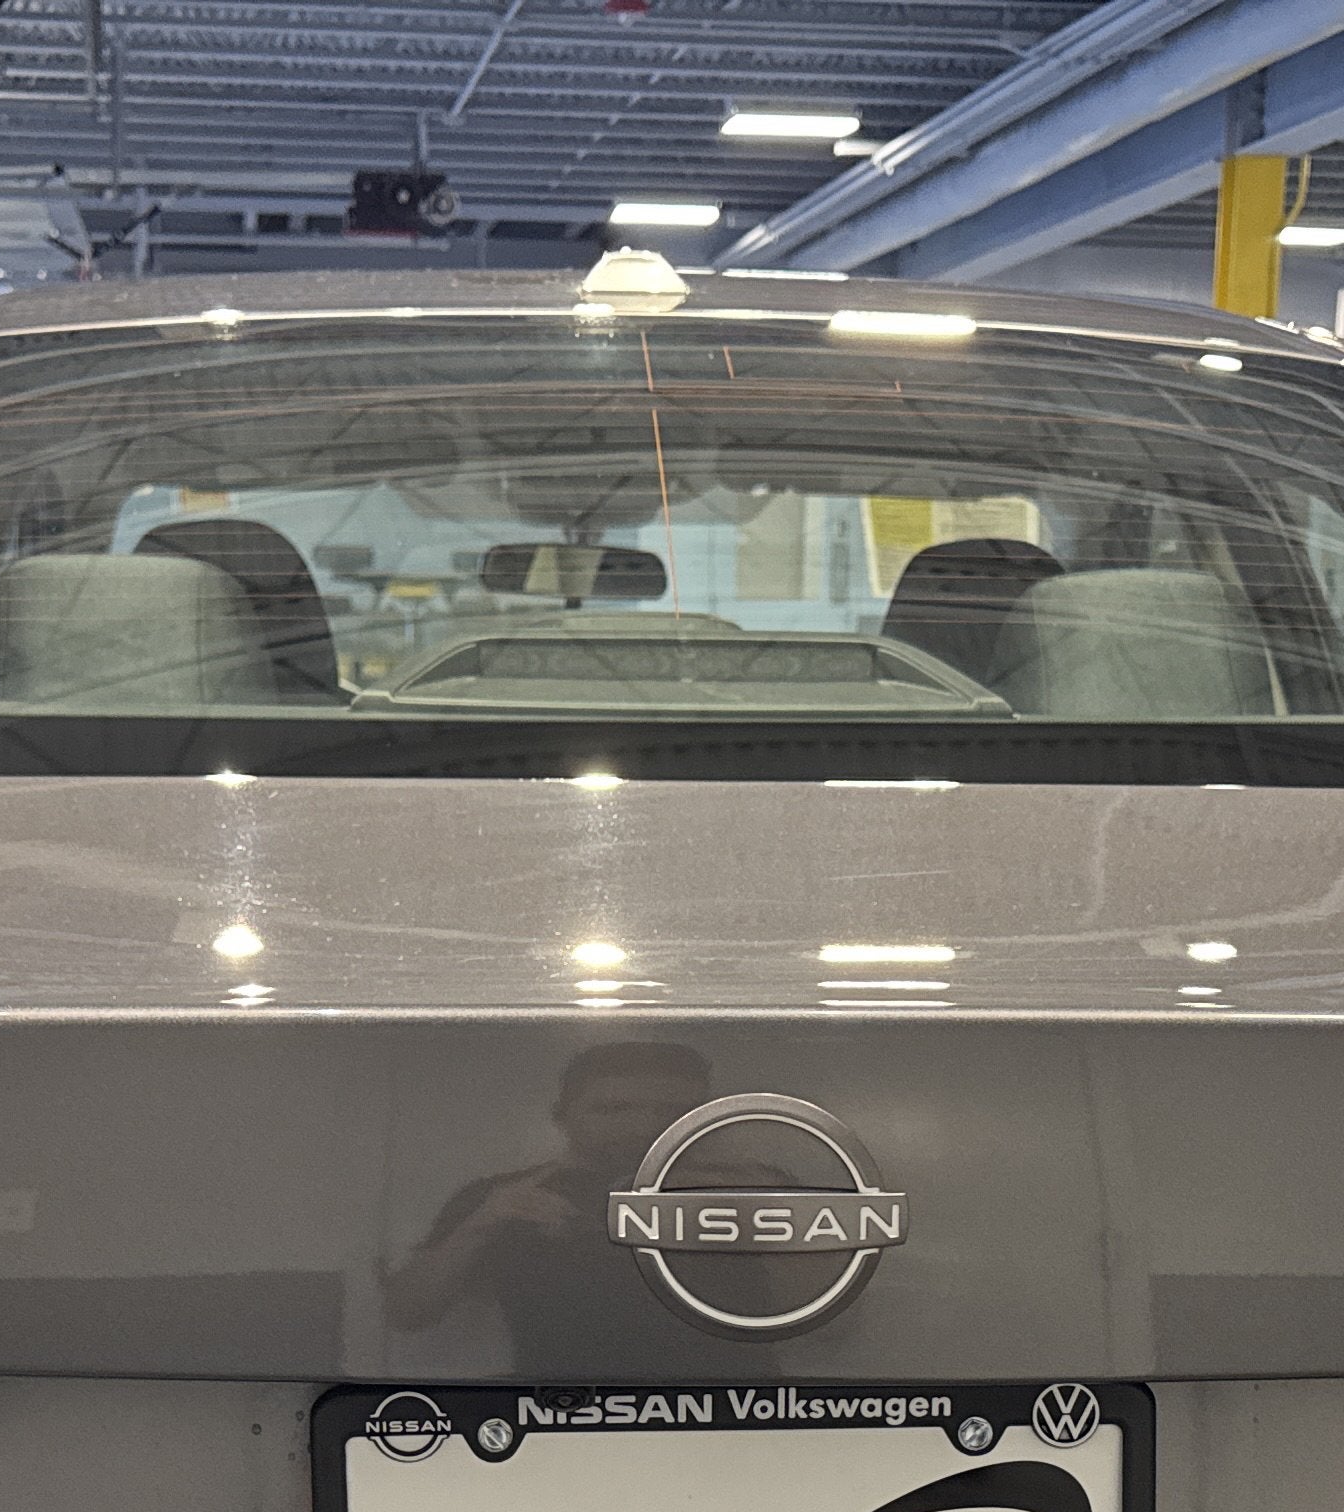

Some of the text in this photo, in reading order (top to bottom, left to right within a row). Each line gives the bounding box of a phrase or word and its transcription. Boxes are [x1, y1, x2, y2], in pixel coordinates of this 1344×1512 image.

[617, 1203, 901, 1242] NISSAN
[727, 1387, 953, 1426] Volkswagen
[365, 1420, 452, 1434] NISSAN
